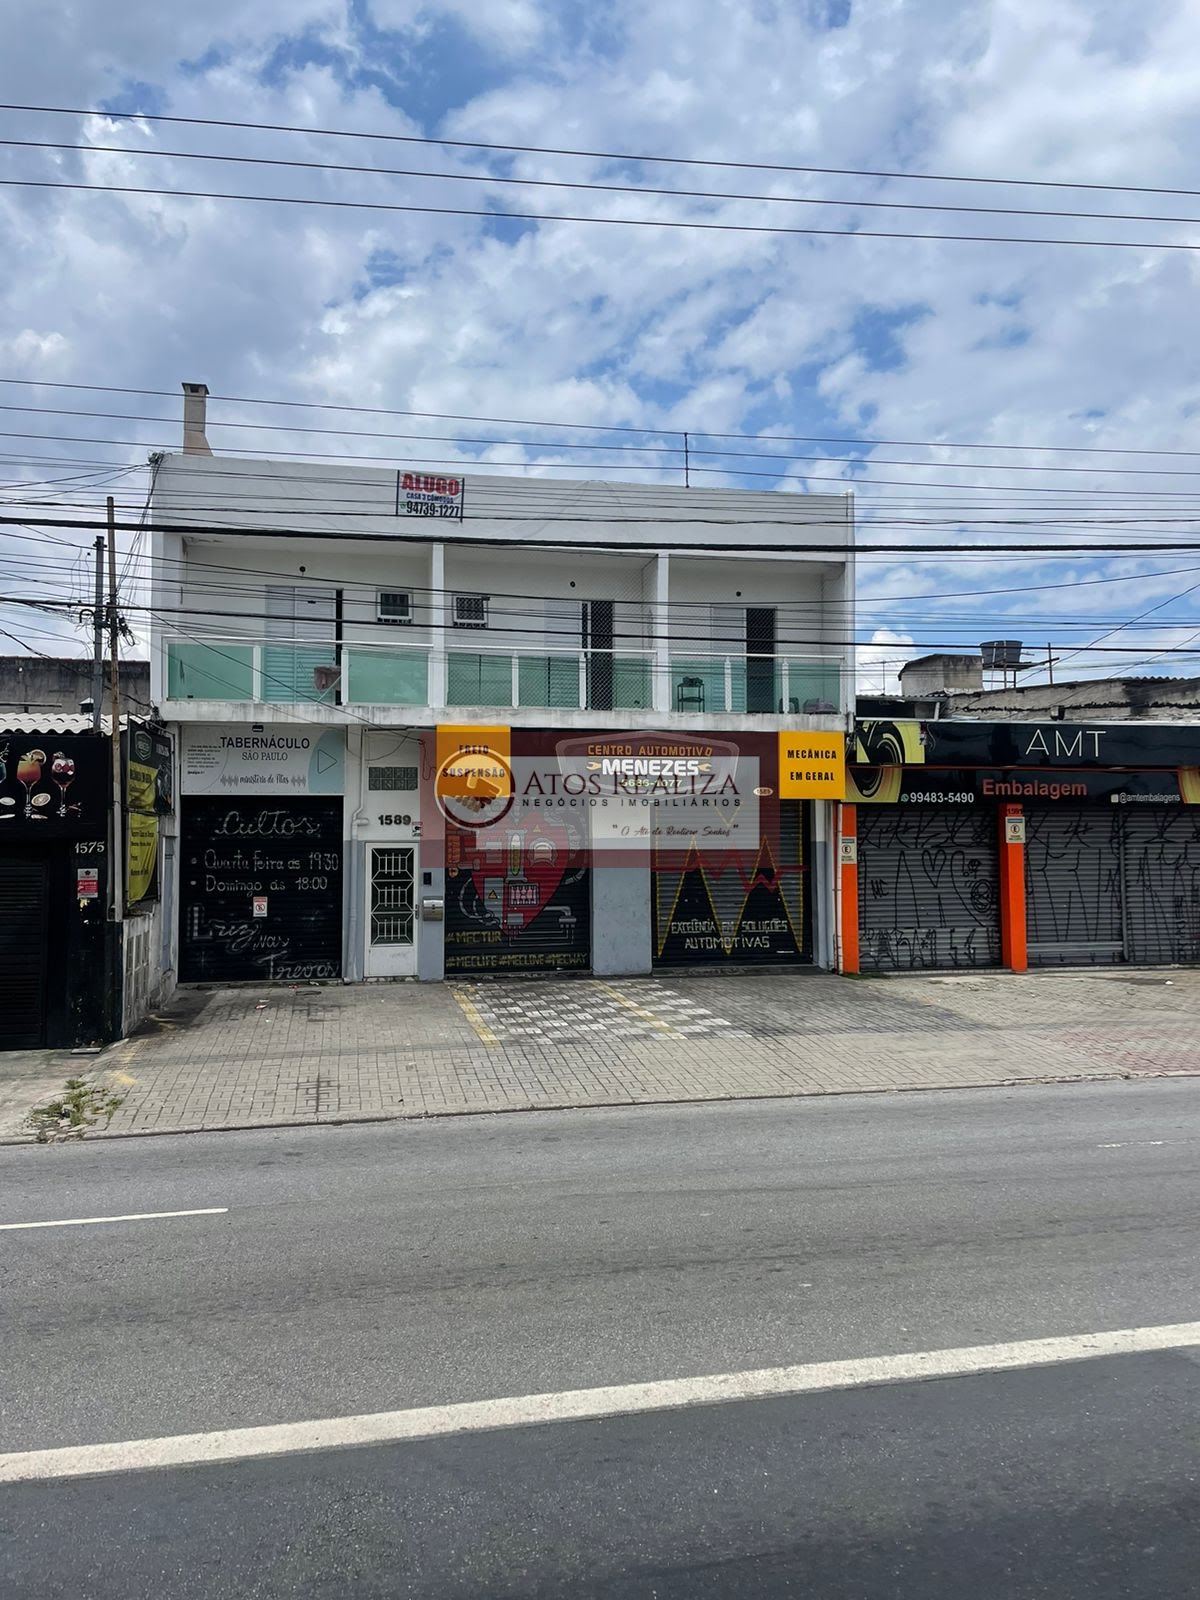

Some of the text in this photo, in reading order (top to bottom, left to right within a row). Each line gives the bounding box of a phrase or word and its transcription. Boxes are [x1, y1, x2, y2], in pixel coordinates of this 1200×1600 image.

[402, 474, 459, 496] ALUGO
[406, 501, 460, 517] 94739-1227
[220, 735, 310, 749] TABERNÁCULO
[1025, 728, 1107, 758] AMT
[241, 751, 288, 761] SÃO PAULO
[458, 744, 489, 755] FREIO
[587, 744, 713, 757] CENTRO AUTOMOTIVO
[787, 749, 837, 760] MECÂNICA
[442, 766, 505, 778] SUSPENSÃO
[602, 758, 700, 777] MENEZES
[790, 772, 835, 781] EM GERAL
[982, 779, 1088, 800] Embalagem
[909, 792, 975, 803] 99483-5490
[1119, 792, 1181, 804] @amtembalagens
[214, 811, 321, 835] Cultos
[378, 815, 411, 825] 1589
[75, 841, 105, 854] 1575
[204, 849, 249, 869] Quarta
[252, 850, 284, 871] feira
[206, 875, 263, 897] Domingo
[295, 876, 328, 890] 18:00
[741, 918, 788, 933] SOLUÇÕES
[684, 935, 770, 949] AUTOMOTIVAS
[446, 955, 497, 968] #MECLIFE
